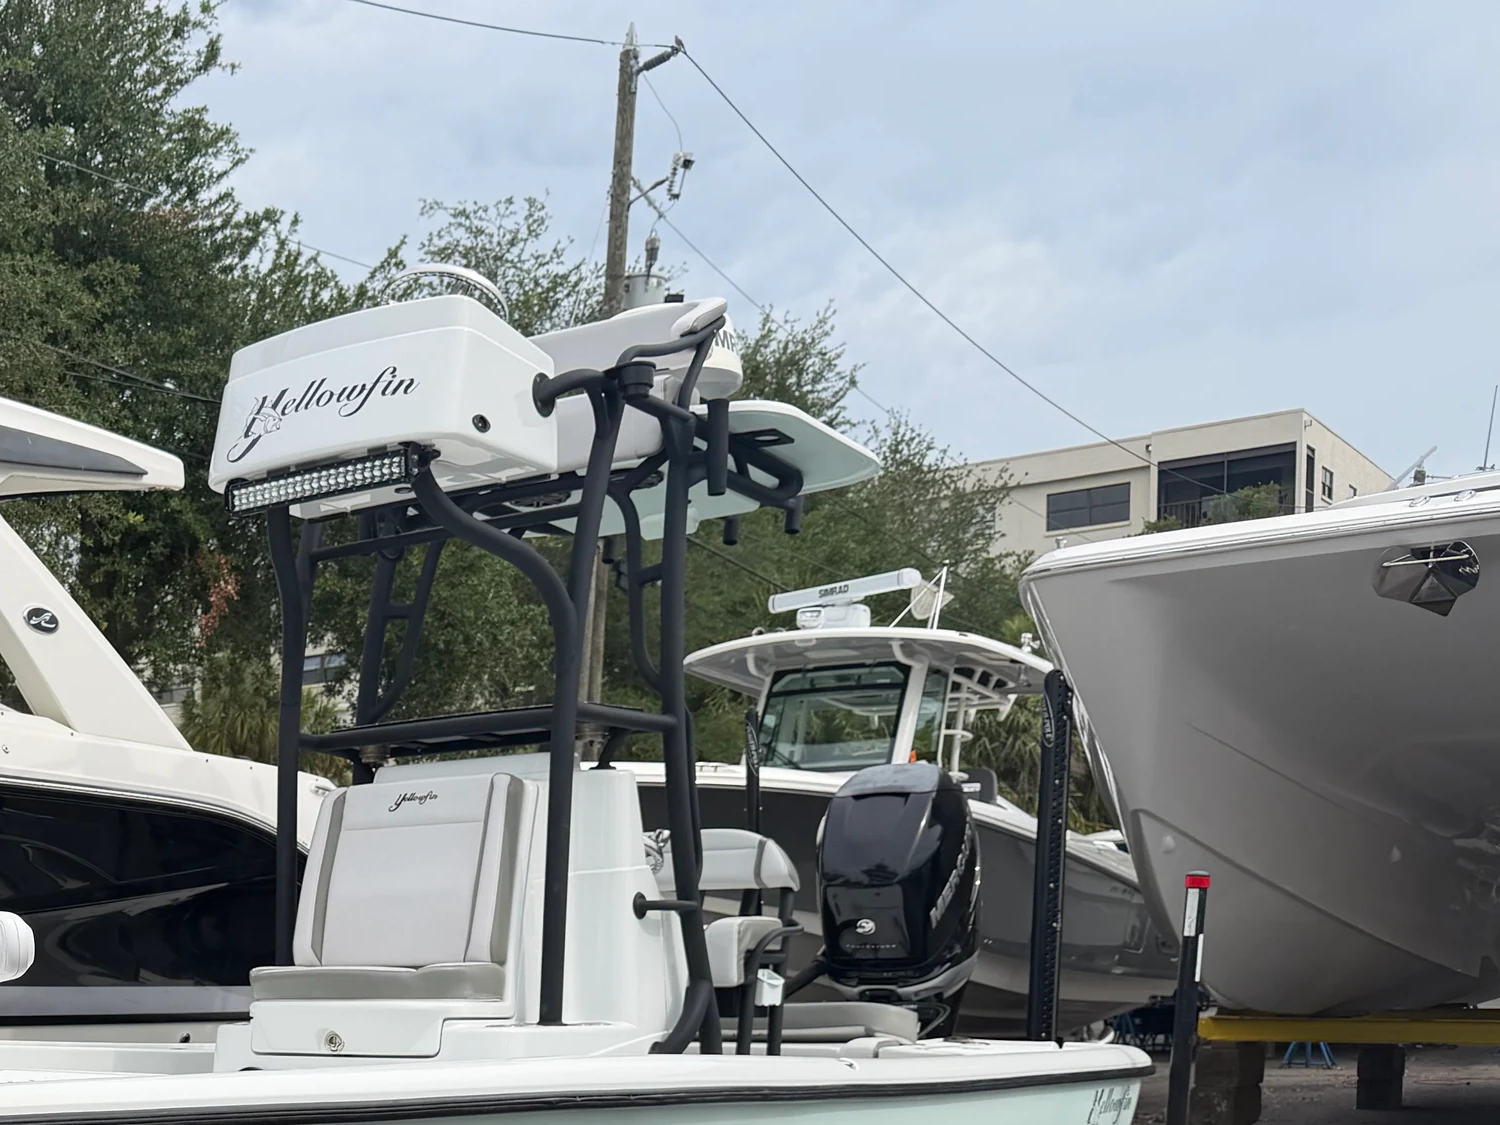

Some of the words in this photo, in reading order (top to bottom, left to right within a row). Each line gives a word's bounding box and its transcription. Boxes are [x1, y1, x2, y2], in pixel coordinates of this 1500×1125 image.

[226, 365, 421, 464] Yellowfin
[818, 584, 850, 598] SIMRAD
[388, 790, 439, 812] Yellowfin
